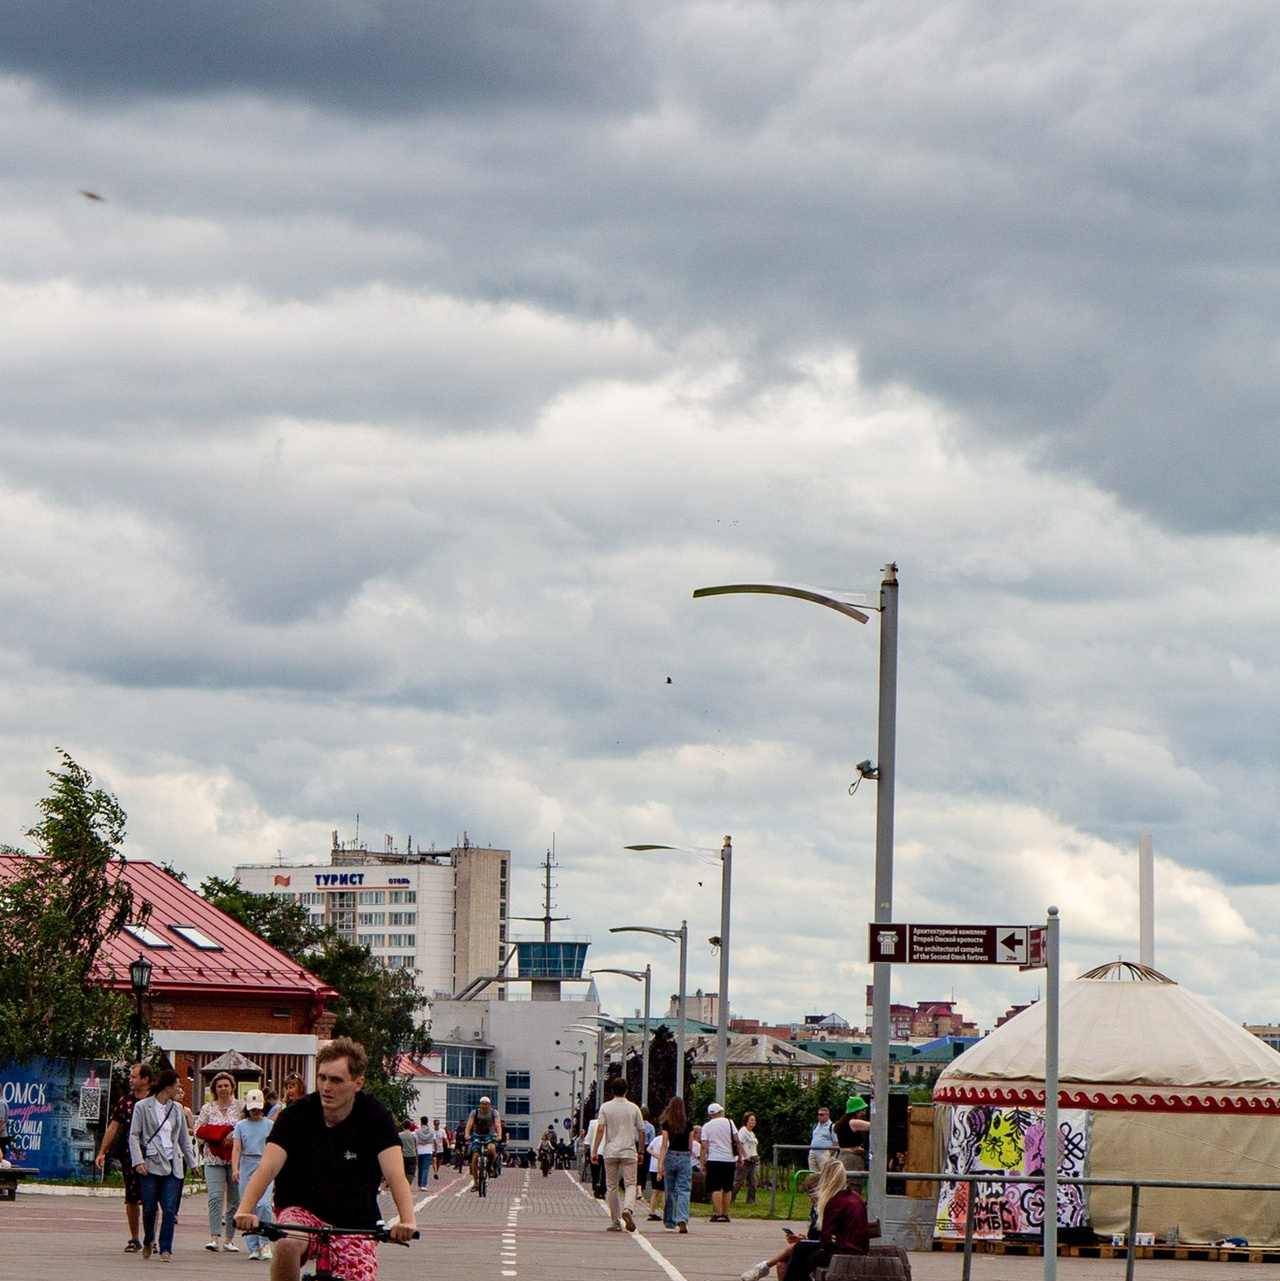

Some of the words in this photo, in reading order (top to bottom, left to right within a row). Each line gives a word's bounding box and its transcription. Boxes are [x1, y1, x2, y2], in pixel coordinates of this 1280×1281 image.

[315, 873, 364, 886] ТУРИСТ
[913, 927, 958, 936] Архитектурный
[913, 935, 934, 943] Второй
[3, 1081, 46, 1105] ОМСК
[8, 1119, 43, 1134] ТОЛИЦА
